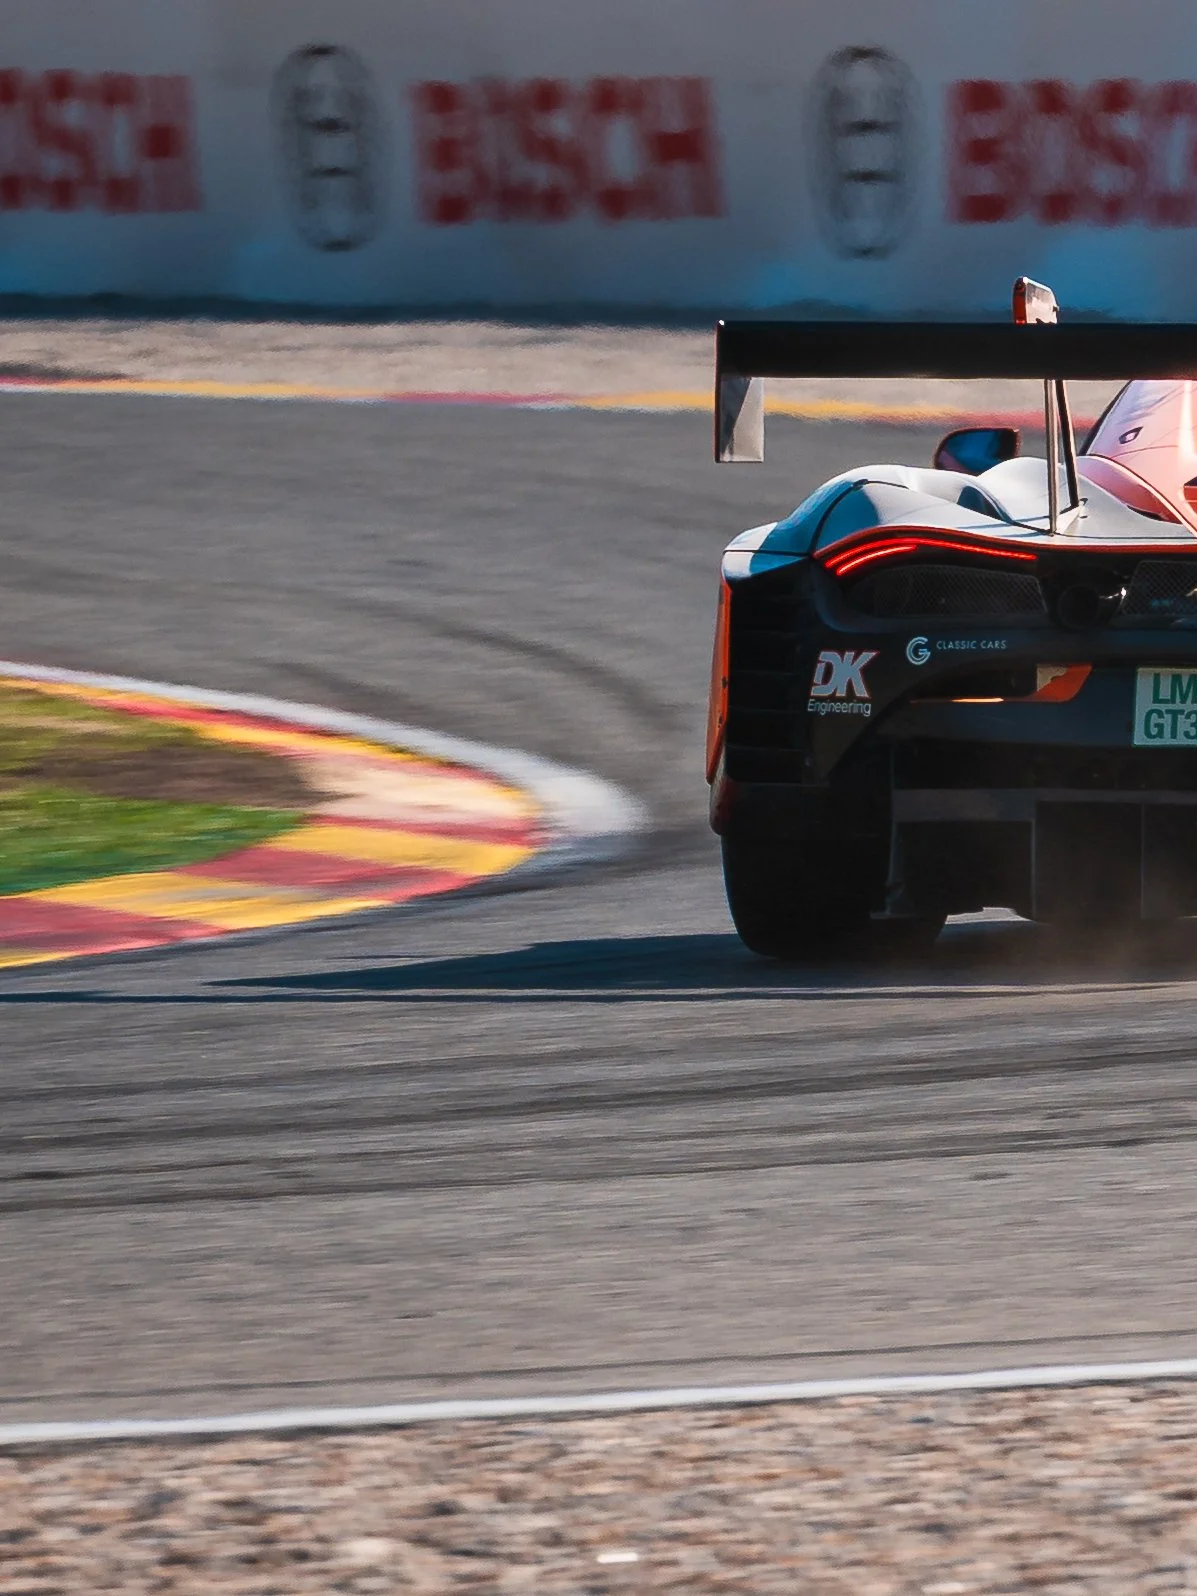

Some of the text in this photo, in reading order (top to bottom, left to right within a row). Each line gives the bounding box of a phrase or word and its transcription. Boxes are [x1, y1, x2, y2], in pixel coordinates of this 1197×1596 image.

[412, 77, 727, 226] BOSCH
[936, 640, 977, 650] CLASSIC
[980, 640, 1007, 650] CARS
[809, 650, 879, 698] DK
[807, 699, 872, 717] Engineering
